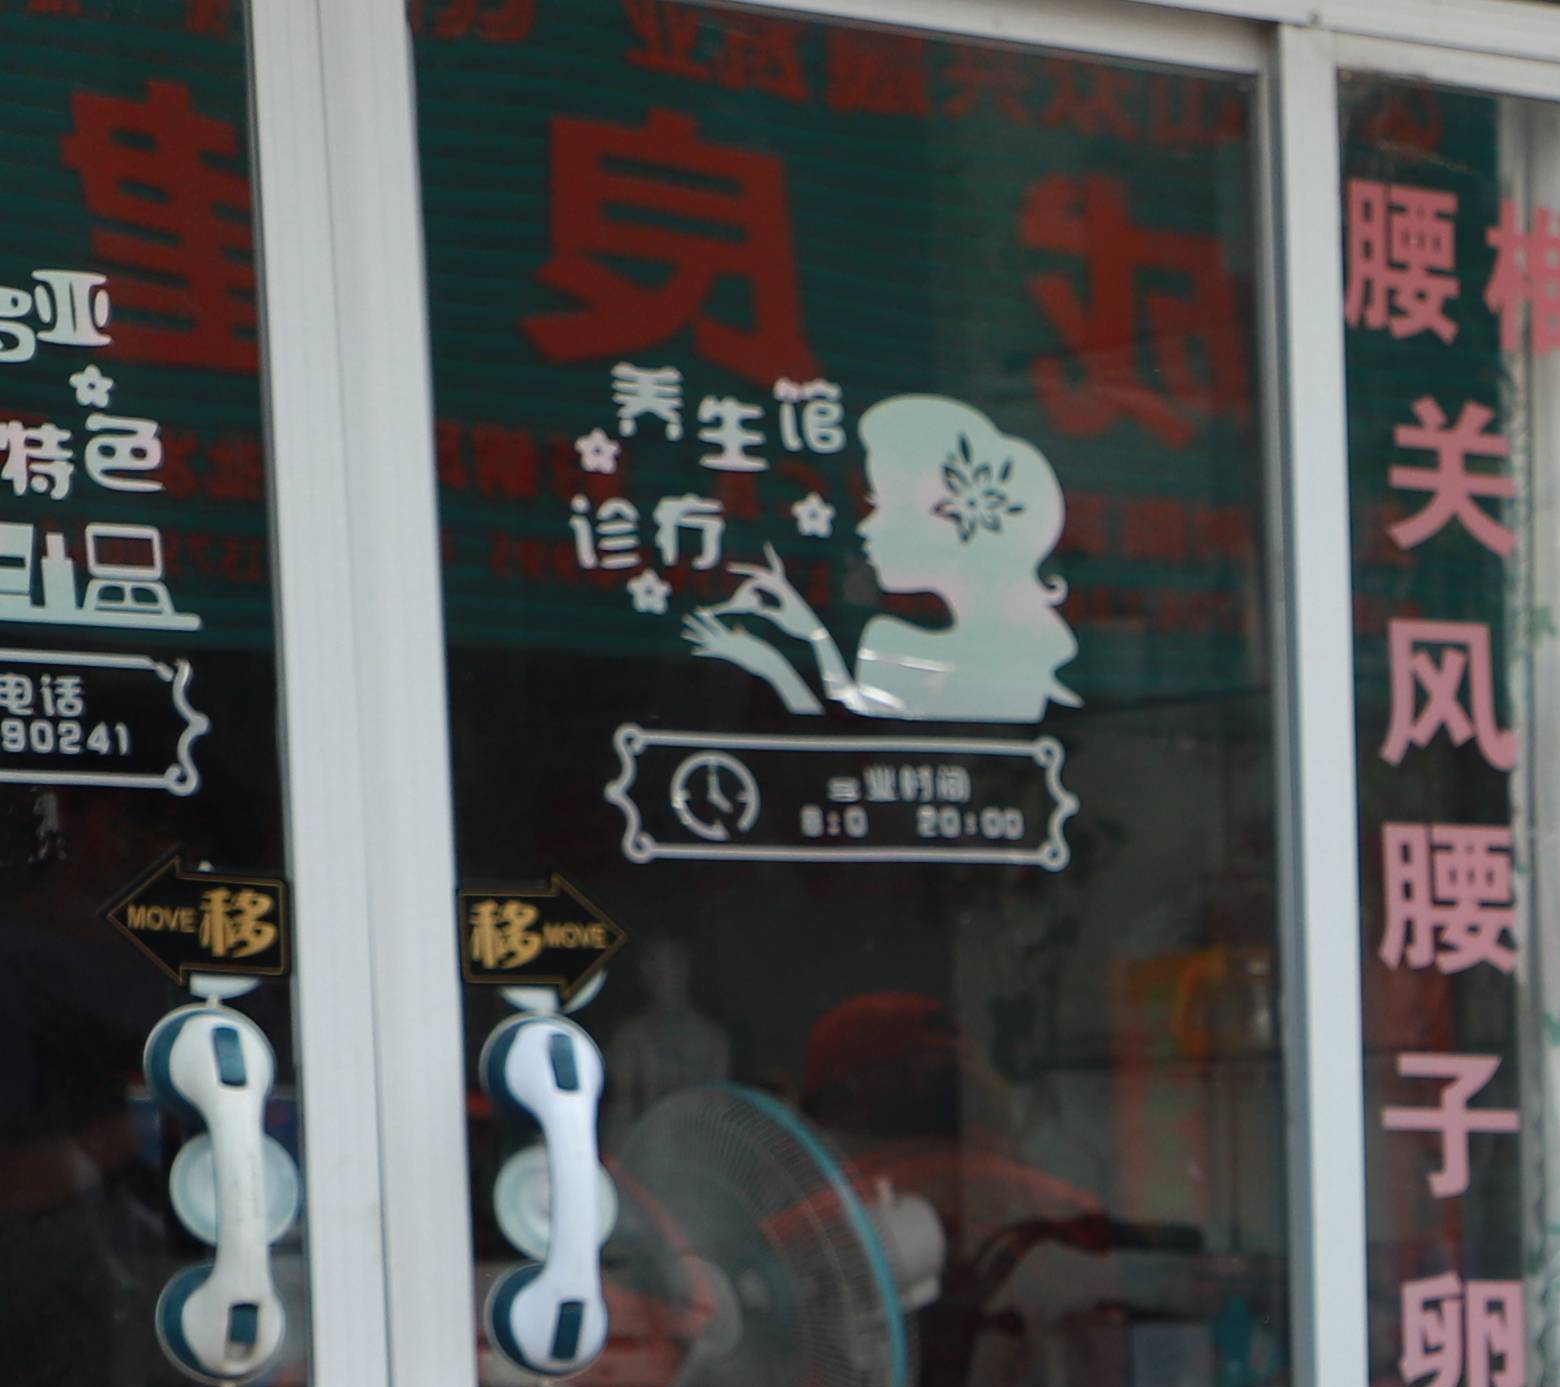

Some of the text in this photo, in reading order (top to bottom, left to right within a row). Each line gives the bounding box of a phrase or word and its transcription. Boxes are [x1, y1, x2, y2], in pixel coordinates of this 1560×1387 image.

[610, 361, 847, 471] 养生馆
[0, 412, 165, 499] 特色
[568, 492, 727, 571] 诊疗
[0, 672, 86, 718] 电话
[1, 717, 131, 757] 90241
[126, 886, 278, 959] MOVE 移
[468, 899, 607, 970] 移 MOVE
